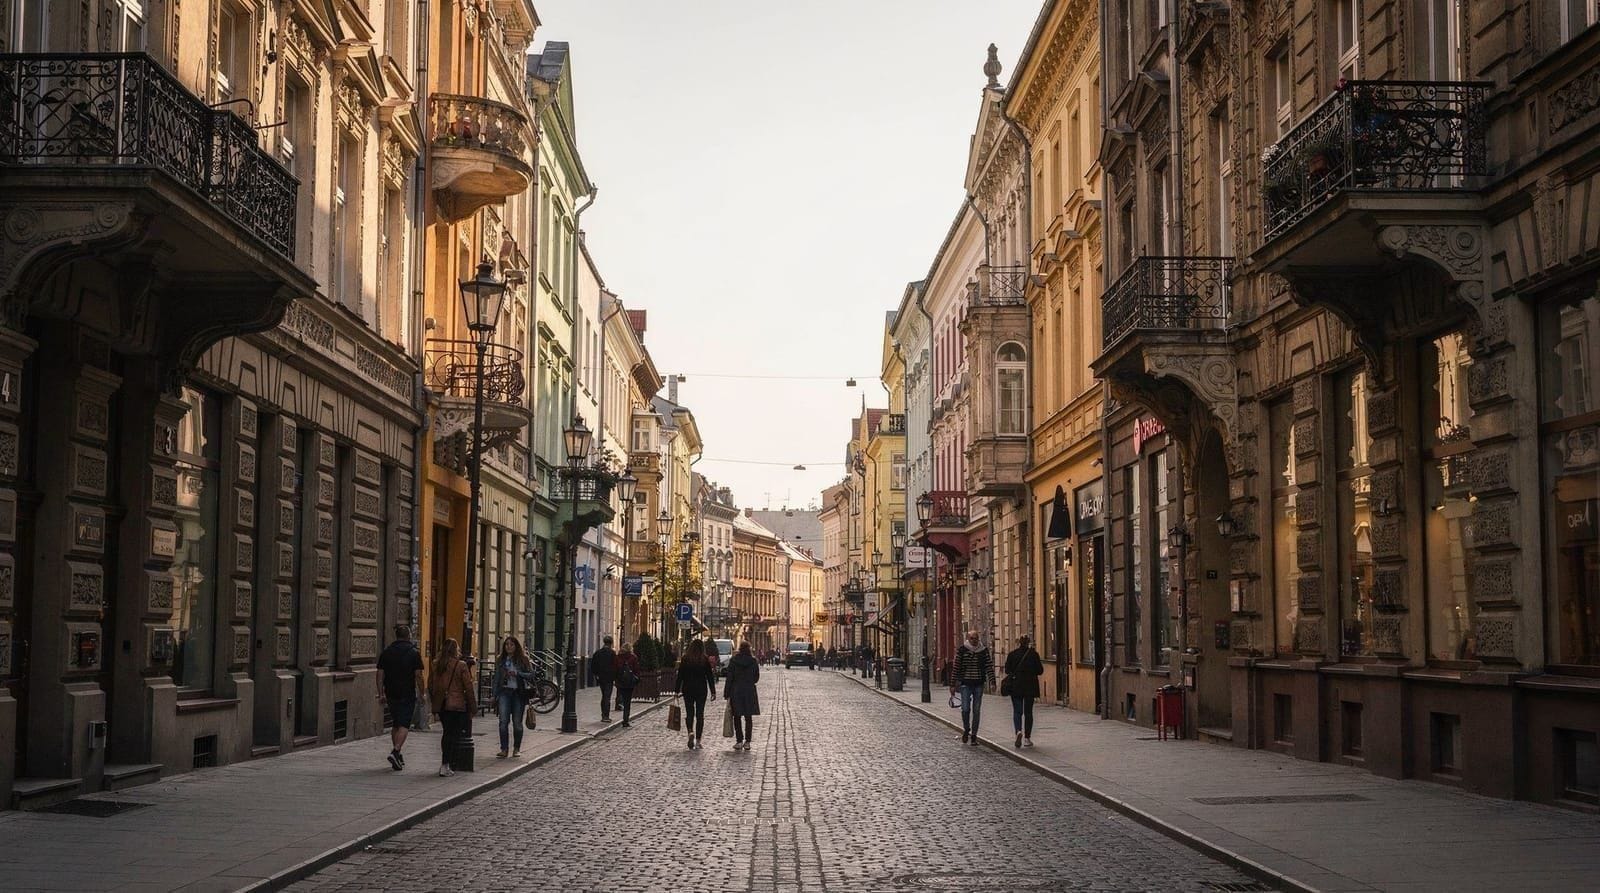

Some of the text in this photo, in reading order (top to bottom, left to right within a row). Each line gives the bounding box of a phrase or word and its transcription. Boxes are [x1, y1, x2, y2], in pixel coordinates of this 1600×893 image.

[2, 373, 10, 402] 4
[165, 426, 172, 454] 3
[681, 605, 690, 619] P
